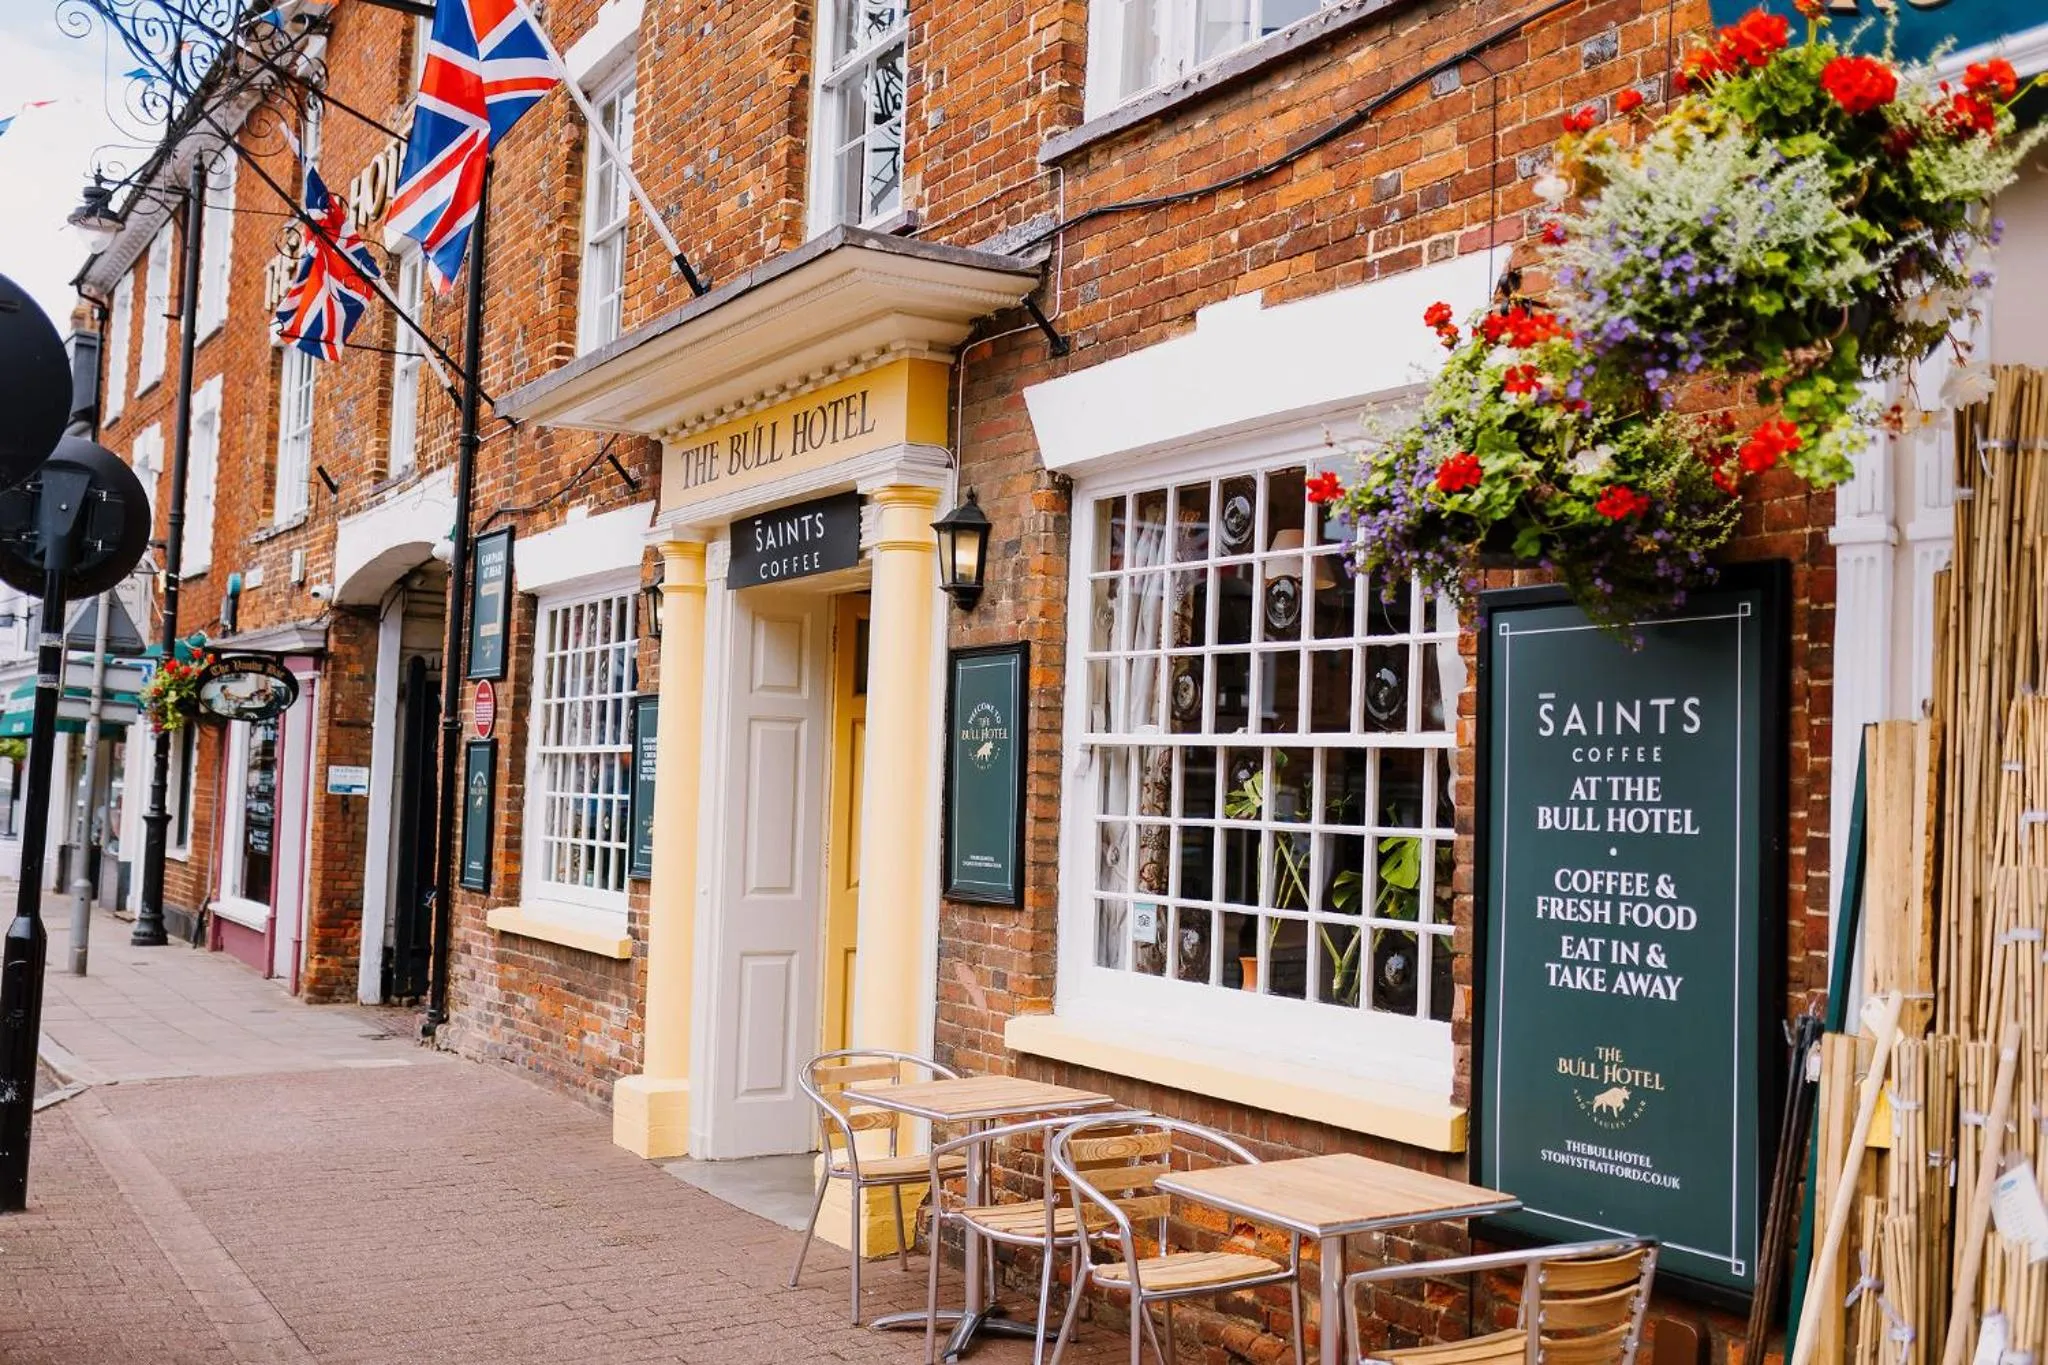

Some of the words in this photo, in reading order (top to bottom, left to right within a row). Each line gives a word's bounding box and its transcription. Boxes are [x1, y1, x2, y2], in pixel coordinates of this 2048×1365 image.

[680, 440, 720, 490] THE
[727, 420, 783, 476] BULL
[791, 390, 876, 457] HOTEL
[754, 512, 825, 553] SAINTS
[759, 552, 820, 579] COFFEE
[968, 702, 995, 725] WELCOME
[994, 709, 1002, 724] TO
[1538, 692, 1701, 737] SAINTS
[961, 727, 980, 740] BULL
[981, 727, 1009, 742] HOTEL
[1572, 746, 1662, 763] COFFEE
[1569, 776, 1602, 801] AT
[1606, 776, 1662, 802] THE
[1537, 806, 1601, 832] BULL
[1606, 807, 1701, 835] HOTEL
[1554, 868, 1650, 898] COFFEE
[1655, 873, 1678, 900] &
[1536, 896, 1612, 925] FRESH
[1619, 902, 1698, 931] FOOD
[1560, 935, 1605, 962] EAT
[1611, 940, 1640, 966] IN
[1646, 943, 1668, 969] &
[1545, 962, 1607, 993] TAKE
[1611, 970, 1684, 1001] AWAY
[1594, 1046, 1624, 1063] THE
[1557, 1056, 1600, 1080] BULL
[1603, 1063, 1665, 1091] HOTEL
[1540, 1148, 1681, 1190] STONYSTRATFORD.CO.UK
[1565, 1139, 1653, 1169] THEBULLHOTEL
